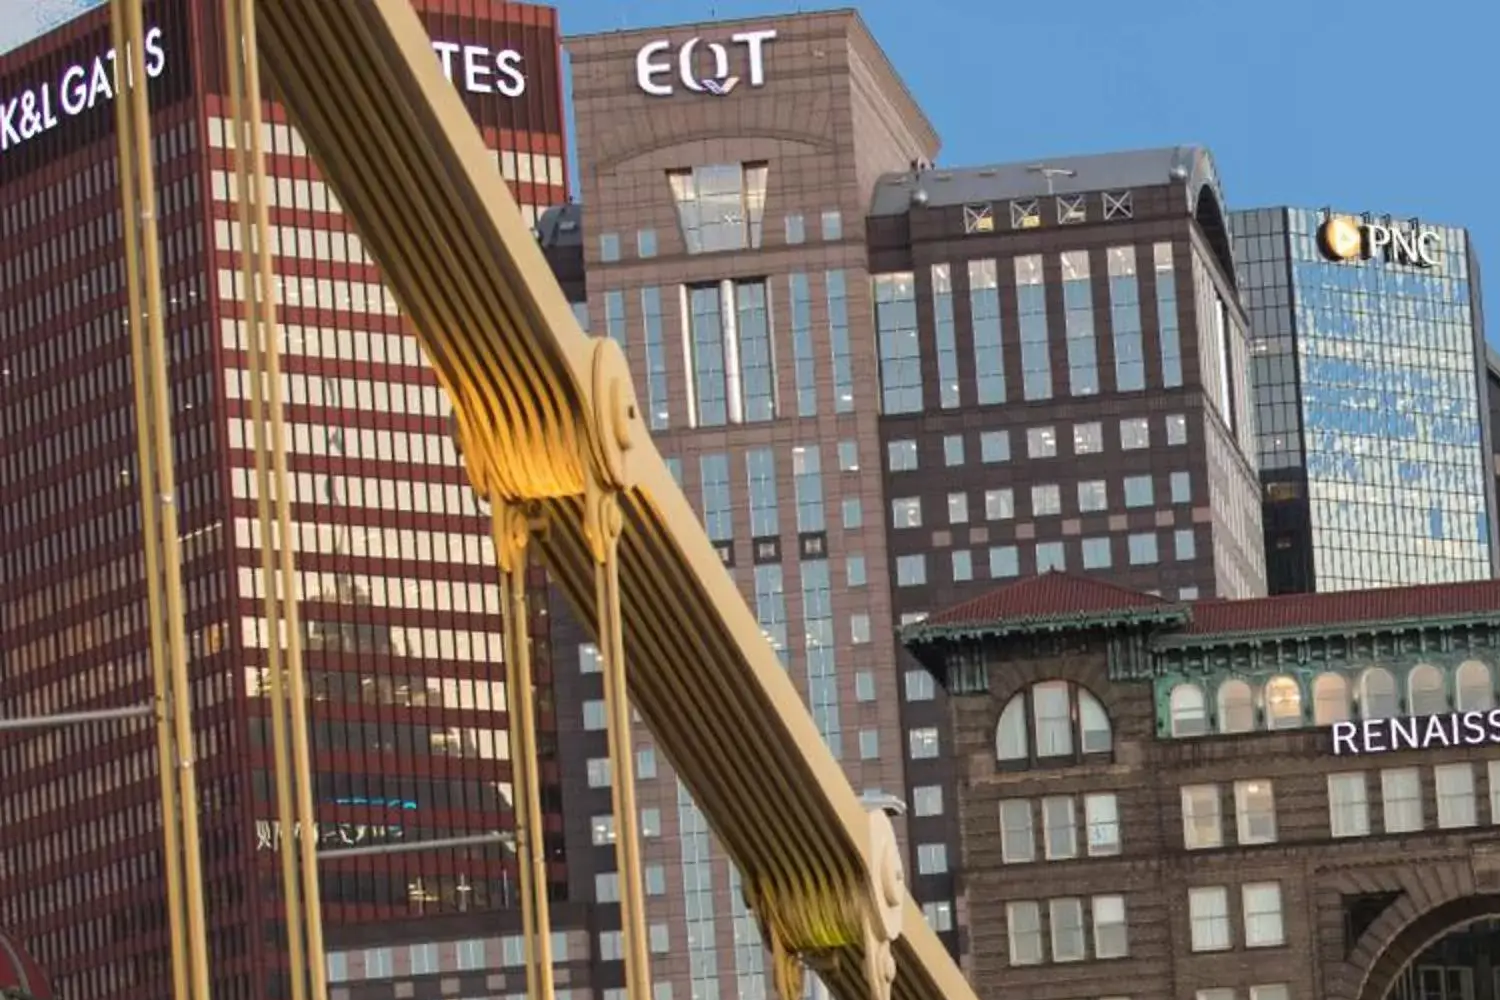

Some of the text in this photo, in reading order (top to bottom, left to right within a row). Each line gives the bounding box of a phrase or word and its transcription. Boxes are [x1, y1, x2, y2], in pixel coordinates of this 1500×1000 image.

[0, 27, 165, 150] K&L GATS
[636, 30, 777, 96] EQT
[1366, 224, 1441, 265] PNC
